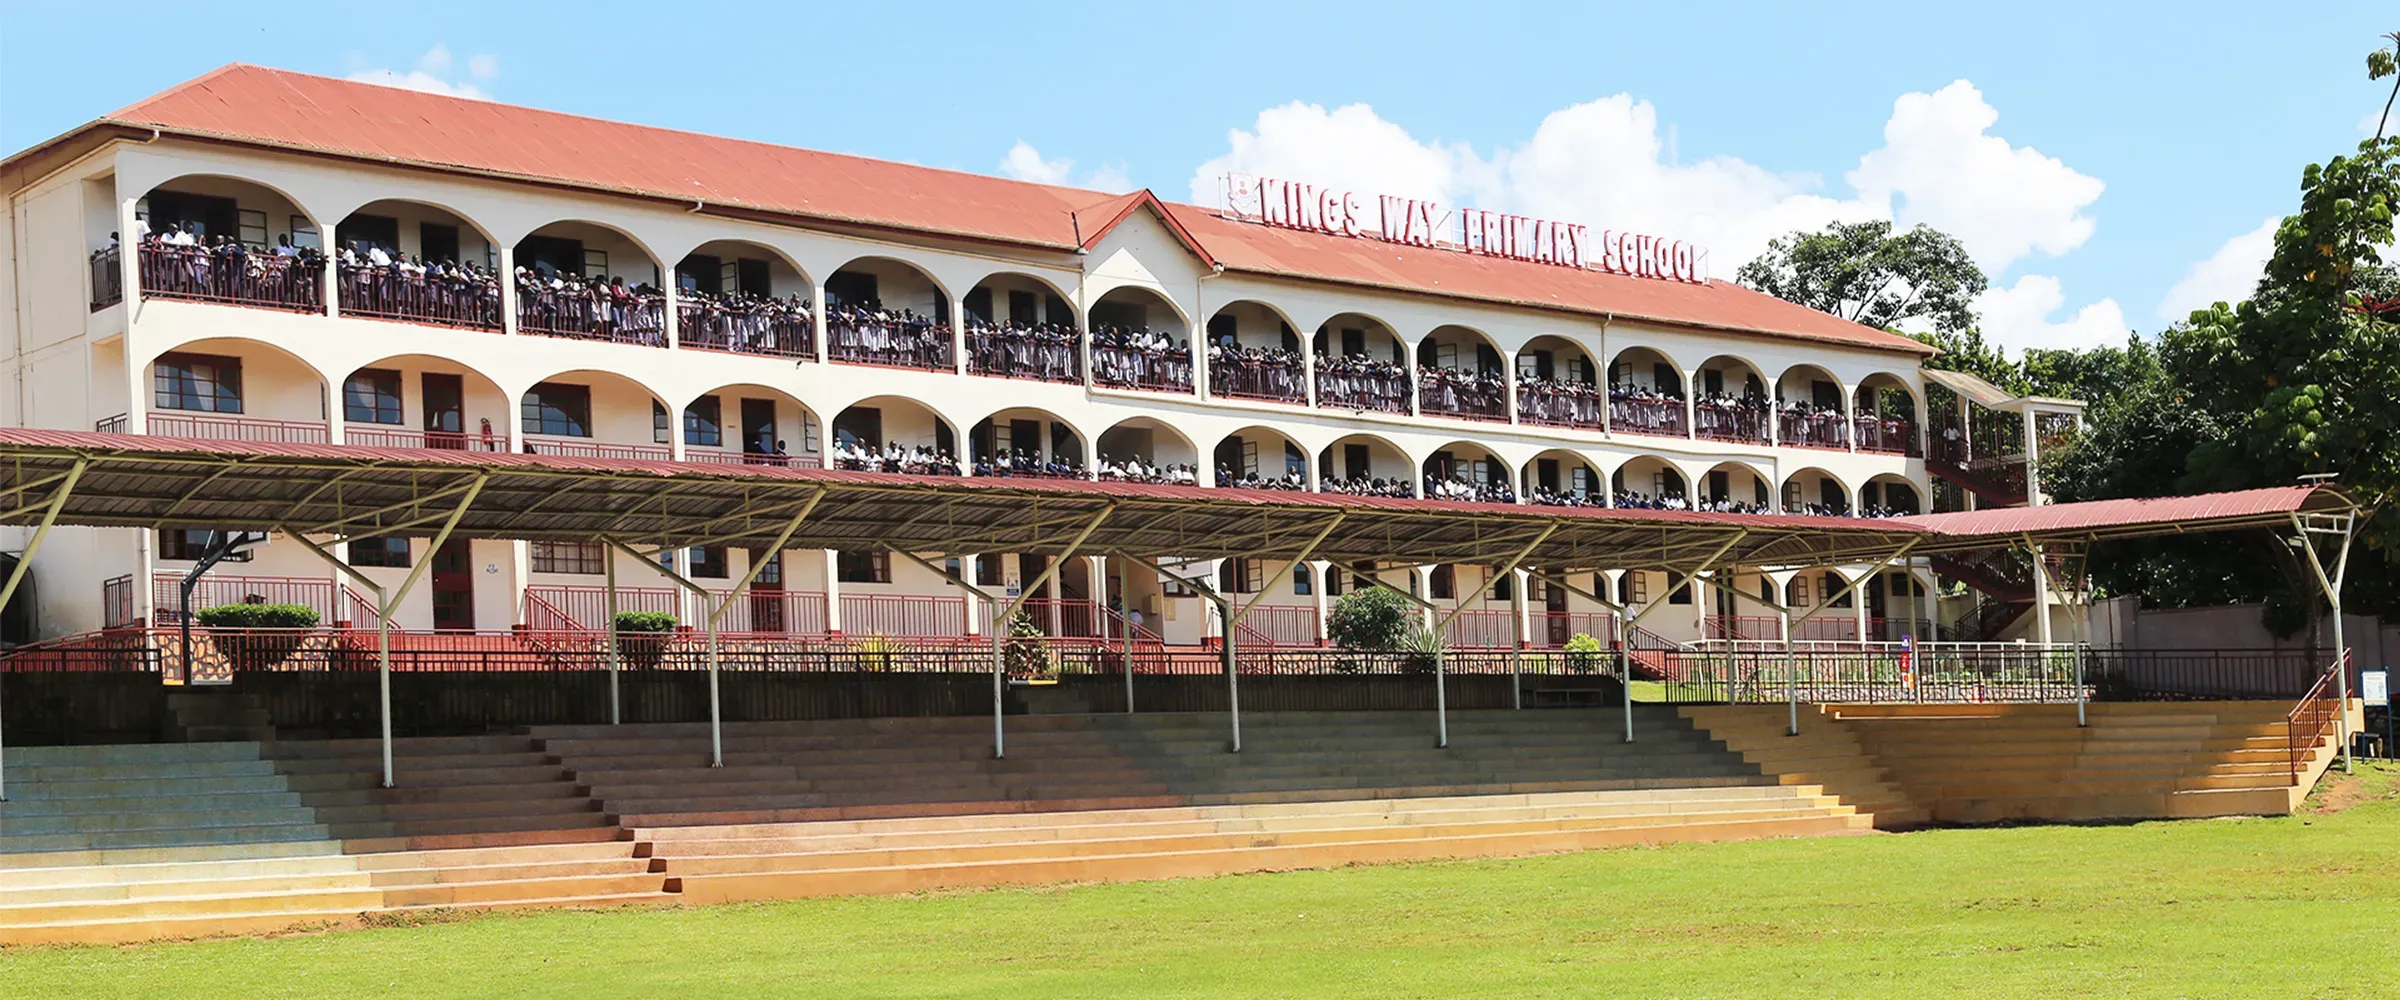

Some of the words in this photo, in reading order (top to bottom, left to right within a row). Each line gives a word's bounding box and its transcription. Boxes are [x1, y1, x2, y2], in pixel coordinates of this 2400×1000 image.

[1260, 177, 1361, 238] KINGS
[1379, 194, 1437, 249] WAY
[1463, 208, 1587, 270] PRIMARY
[1602, 229, 1704, 284] SCHOOL
